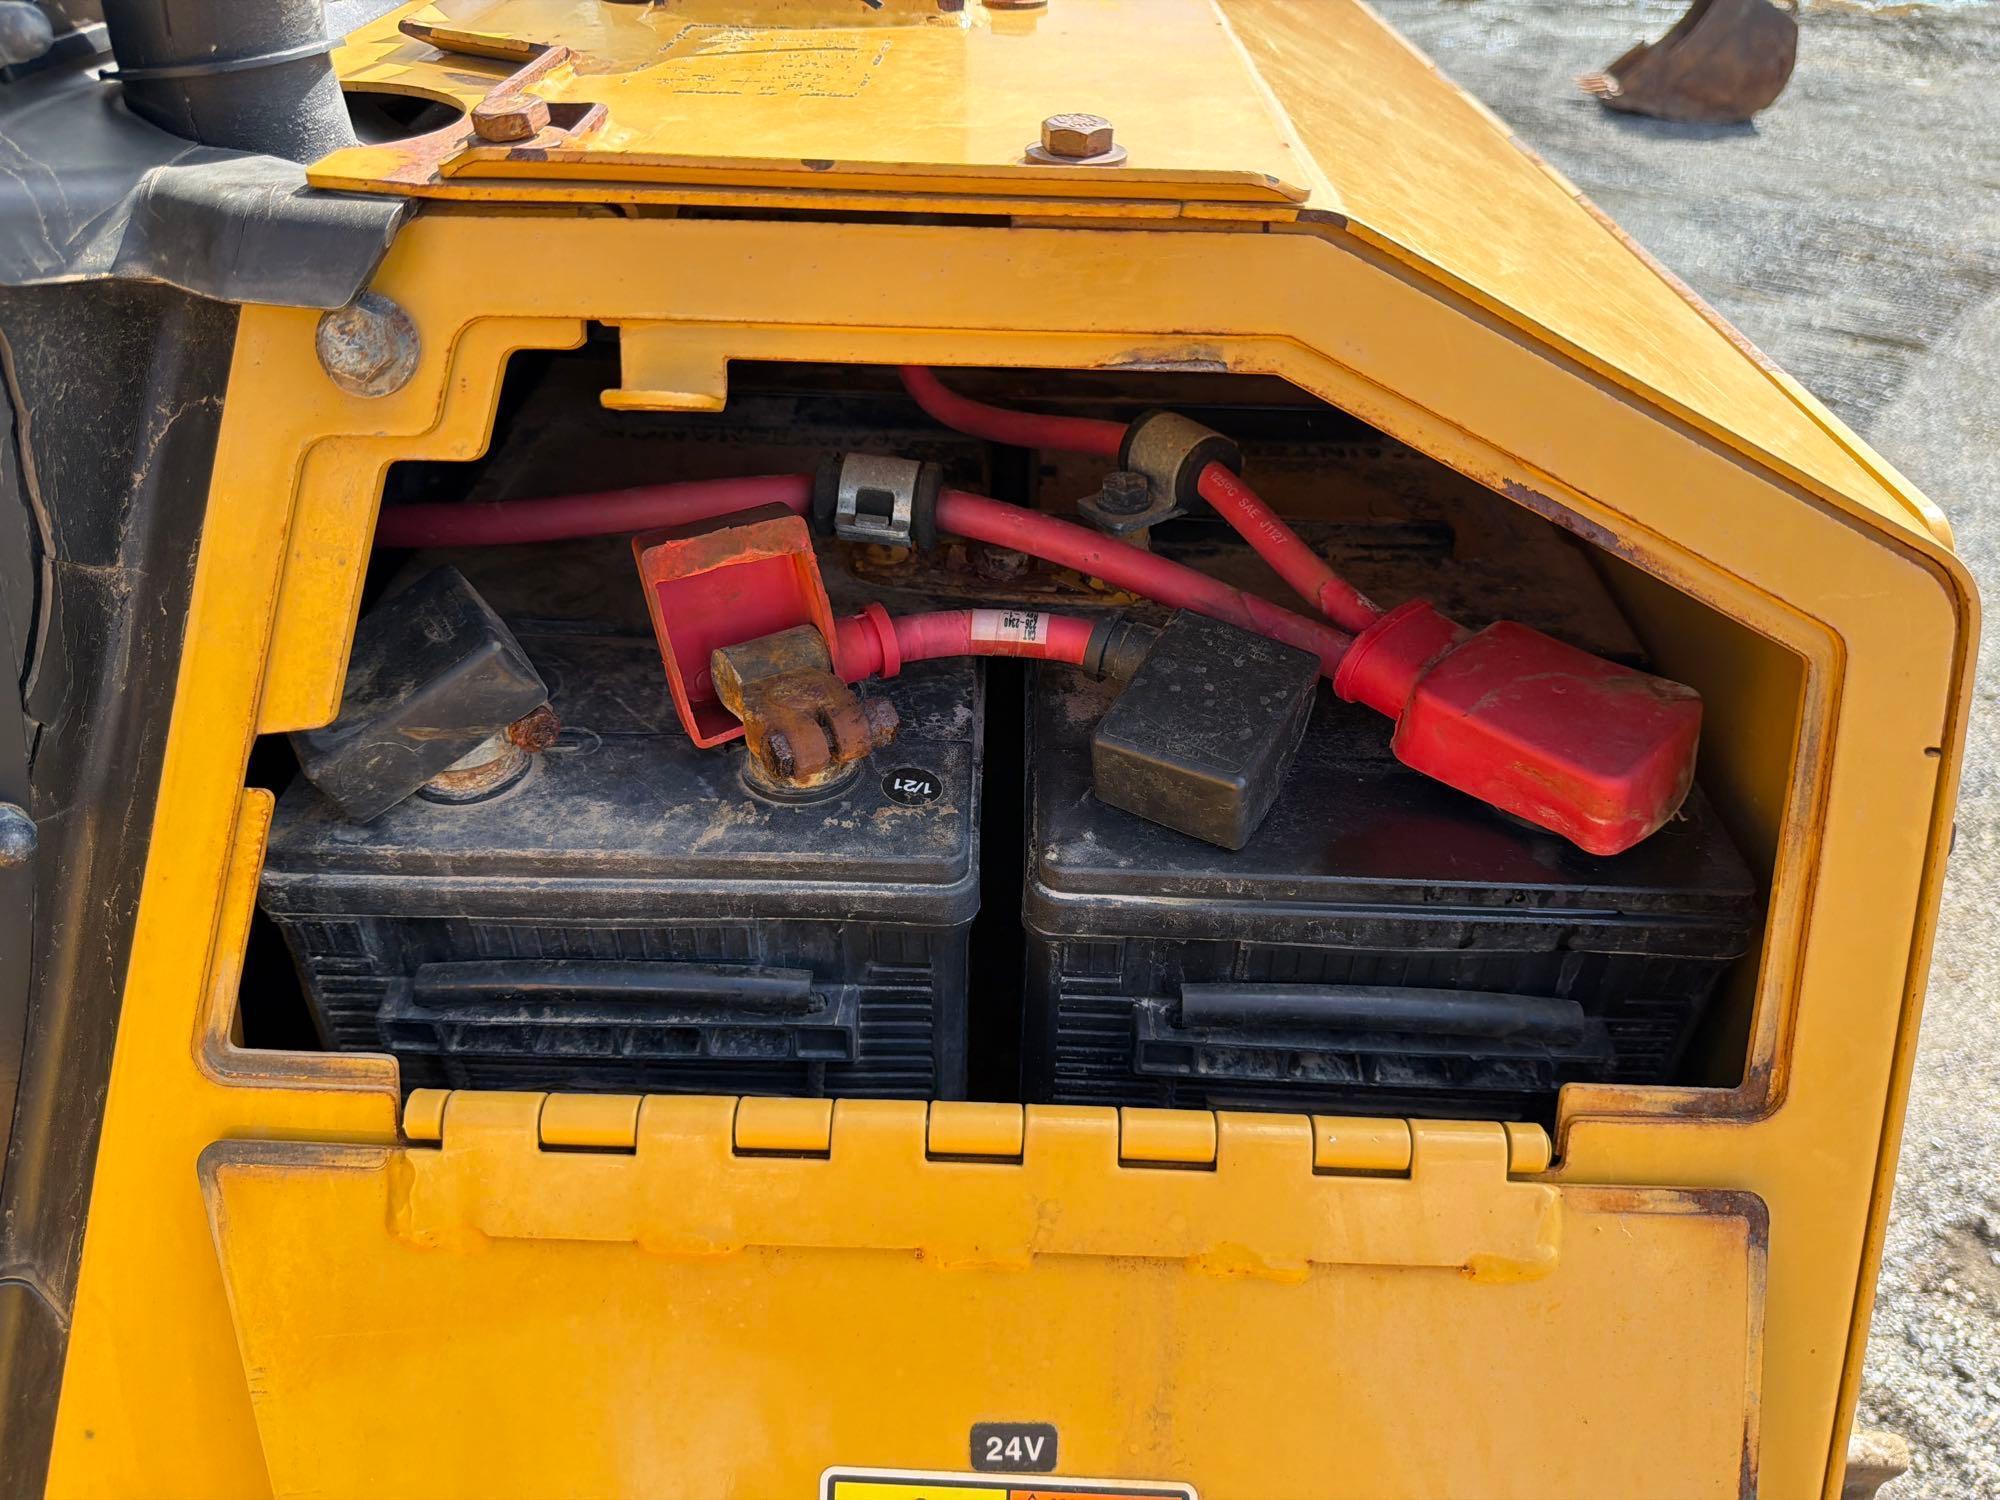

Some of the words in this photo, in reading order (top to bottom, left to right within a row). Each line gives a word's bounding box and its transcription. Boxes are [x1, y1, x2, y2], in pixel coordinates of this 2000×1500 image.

[1238, 498, 1262, 519] SAE
[1259, 520, 1288, 544] J1127
[893, 778, 932, 794] 1/21
[985, 1435, 1045, 1462] 24V
